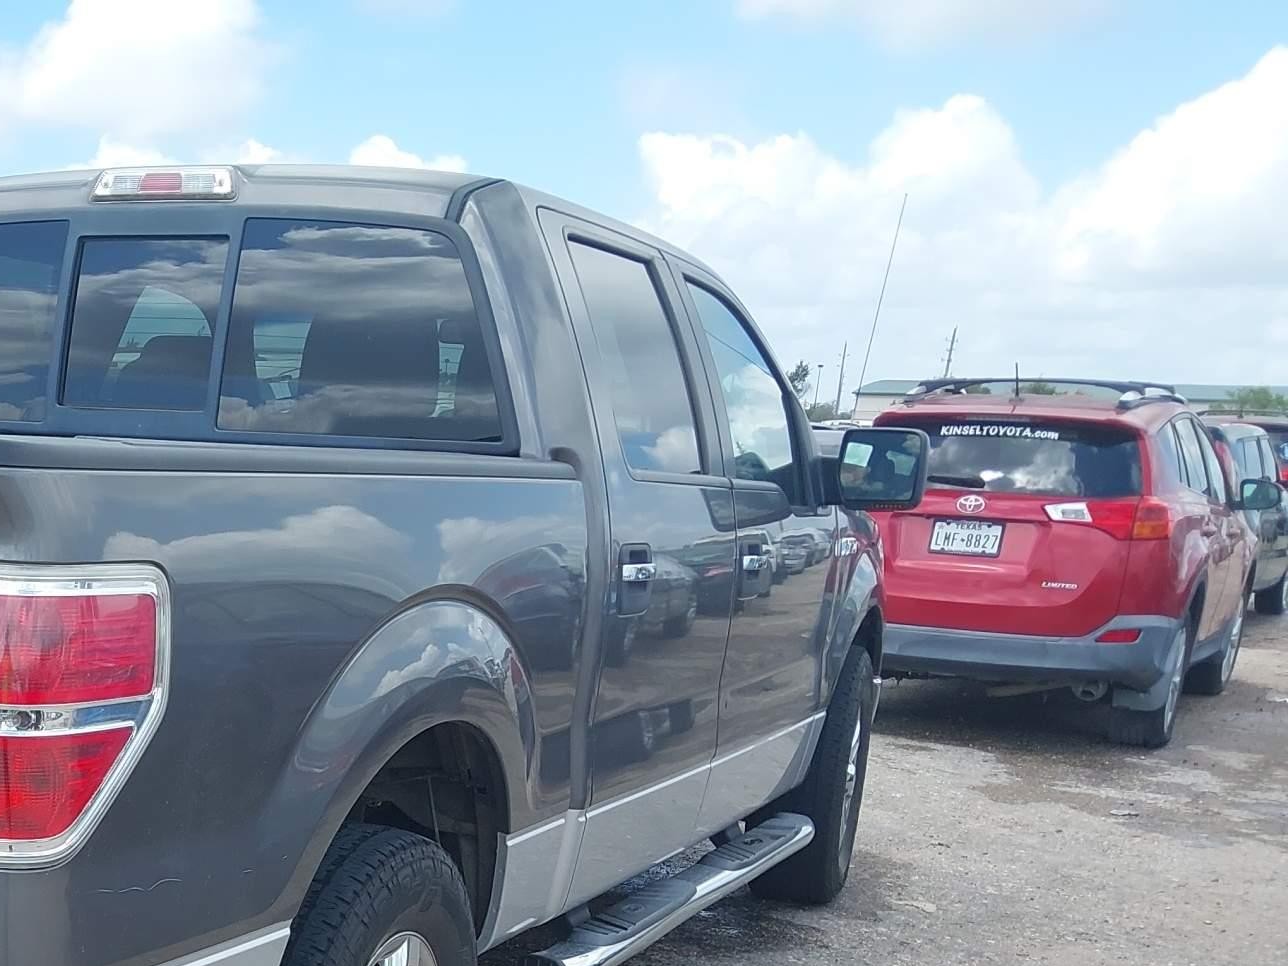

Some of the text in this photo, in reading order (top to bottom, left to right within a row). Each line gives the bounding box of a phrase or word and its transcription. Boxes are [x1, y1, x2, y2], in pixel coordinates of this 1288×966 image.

[940, 425, 1060, 440] KINSELTOYOTA.com
[955, 522, 983, 531] TEXAS
[1041, 581, 1078, 590] LIMITED
